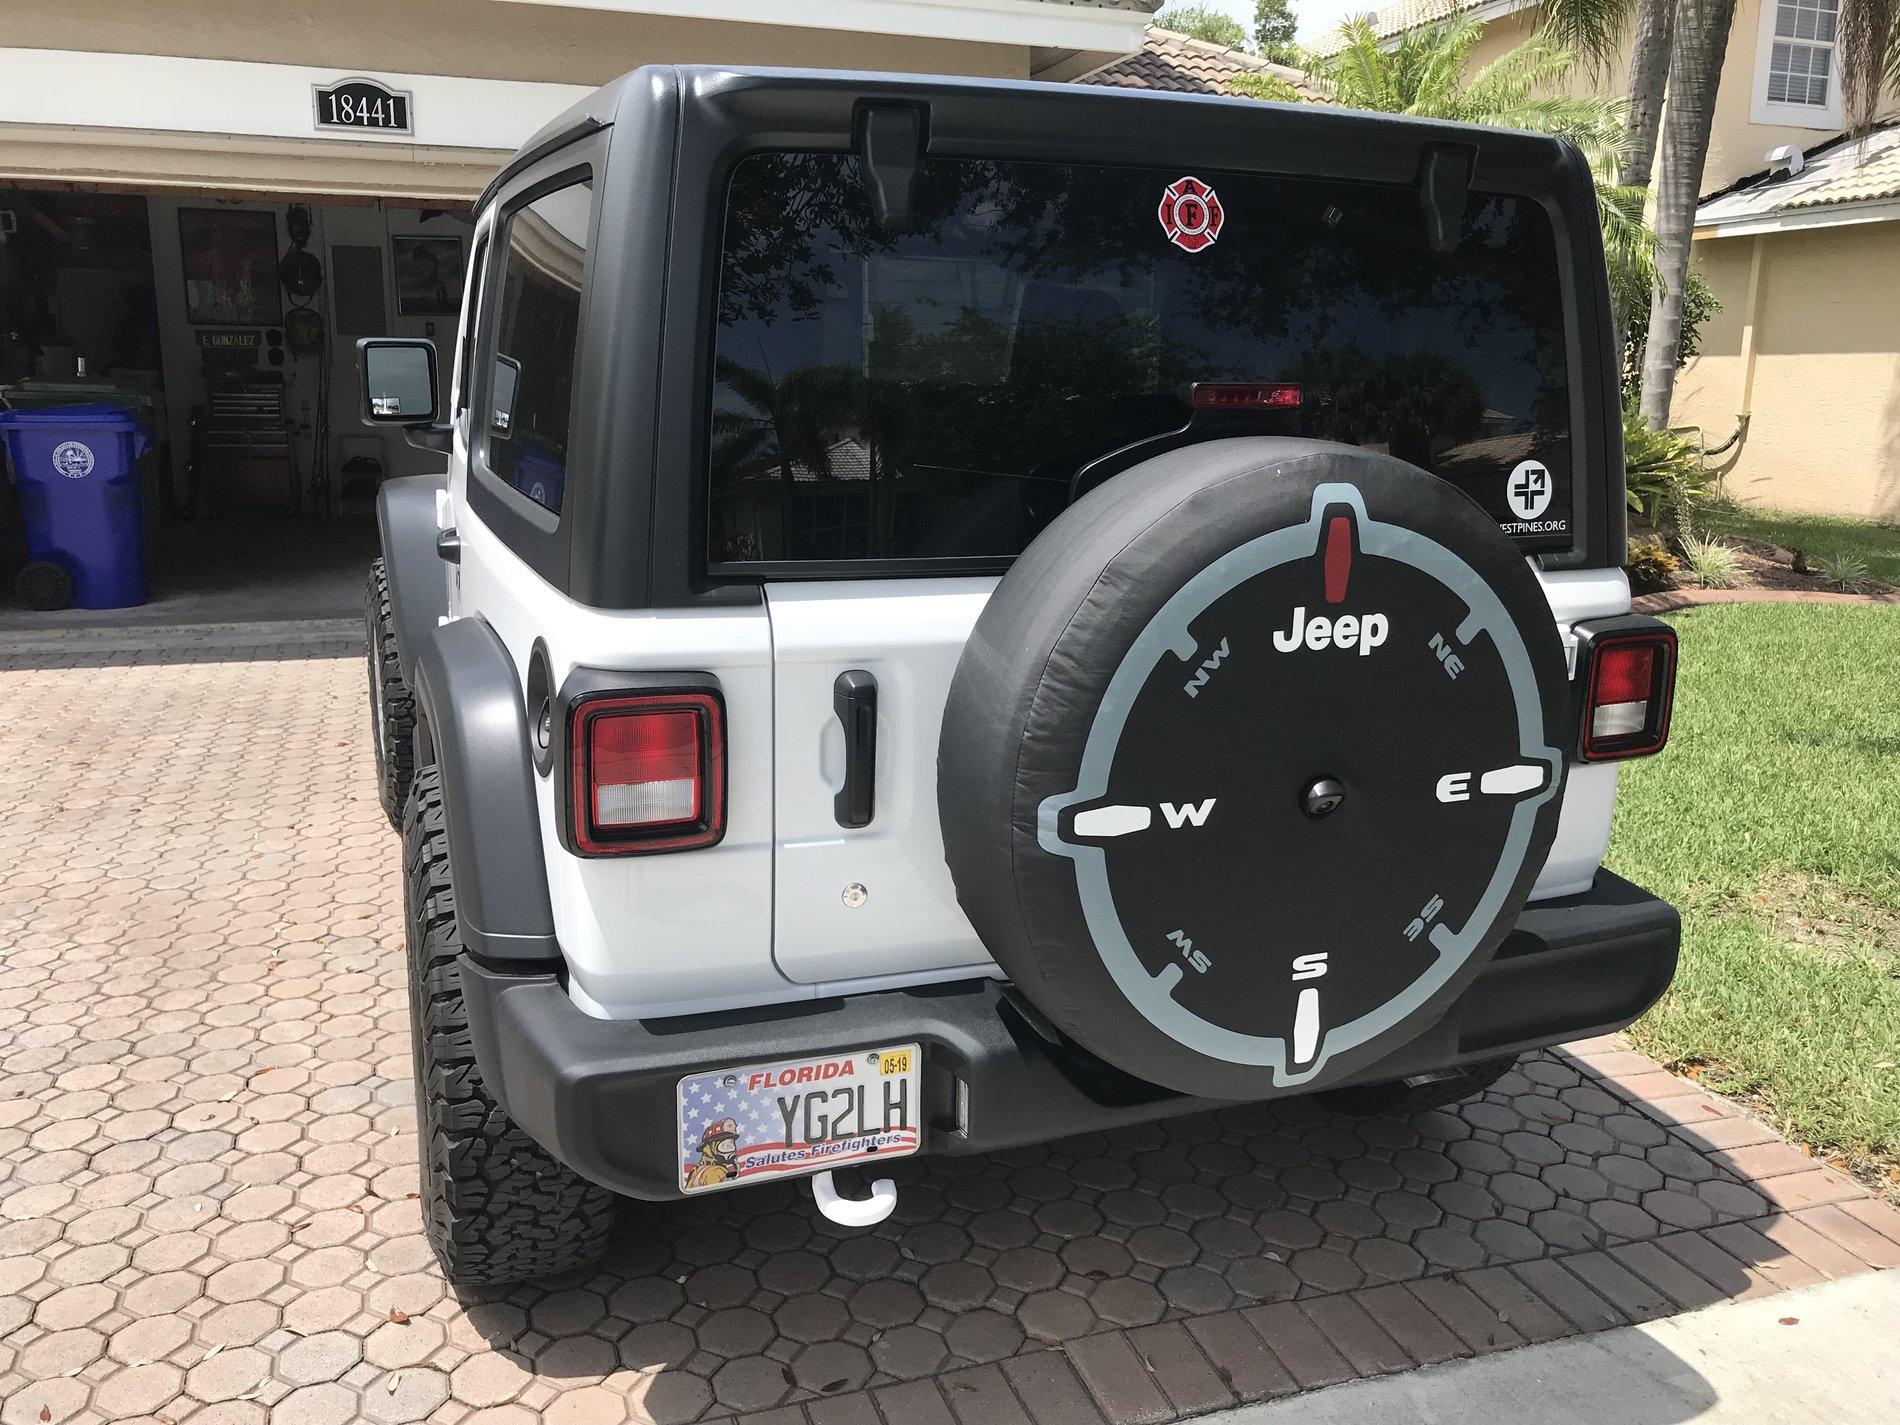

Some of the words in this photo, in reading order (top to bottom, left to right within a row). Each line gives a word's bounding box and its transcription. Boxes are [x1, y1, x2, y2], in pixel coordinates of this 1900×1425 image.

[328, 93, 398, 127] 18441
[1185, 203, 1198, 227] F
[1209, 206, 1220, 226] F
[1500, 520, 1566, 534] ESTPINES.ORG
[1273, 607, 1389, 656] Jeep
[1183, 636, 1230, 699] NW
[1427, 632, 1465, 681] NE
[1436, 772, 1472, 803] E
[1159, 798, 1217, 829] W
[1403, 893, 1444, 942] SE
[1291, 951, 1328, 981] S
[748, 1060, 855, 1091] FLORIDA
[883, 1056, 907, 1075] 05-19
[777, 1078, 907, 1148] YG2LH
[745, 1149, 805, 1169] Salutes
[811, 1133, 901, 1158] Firefighters
